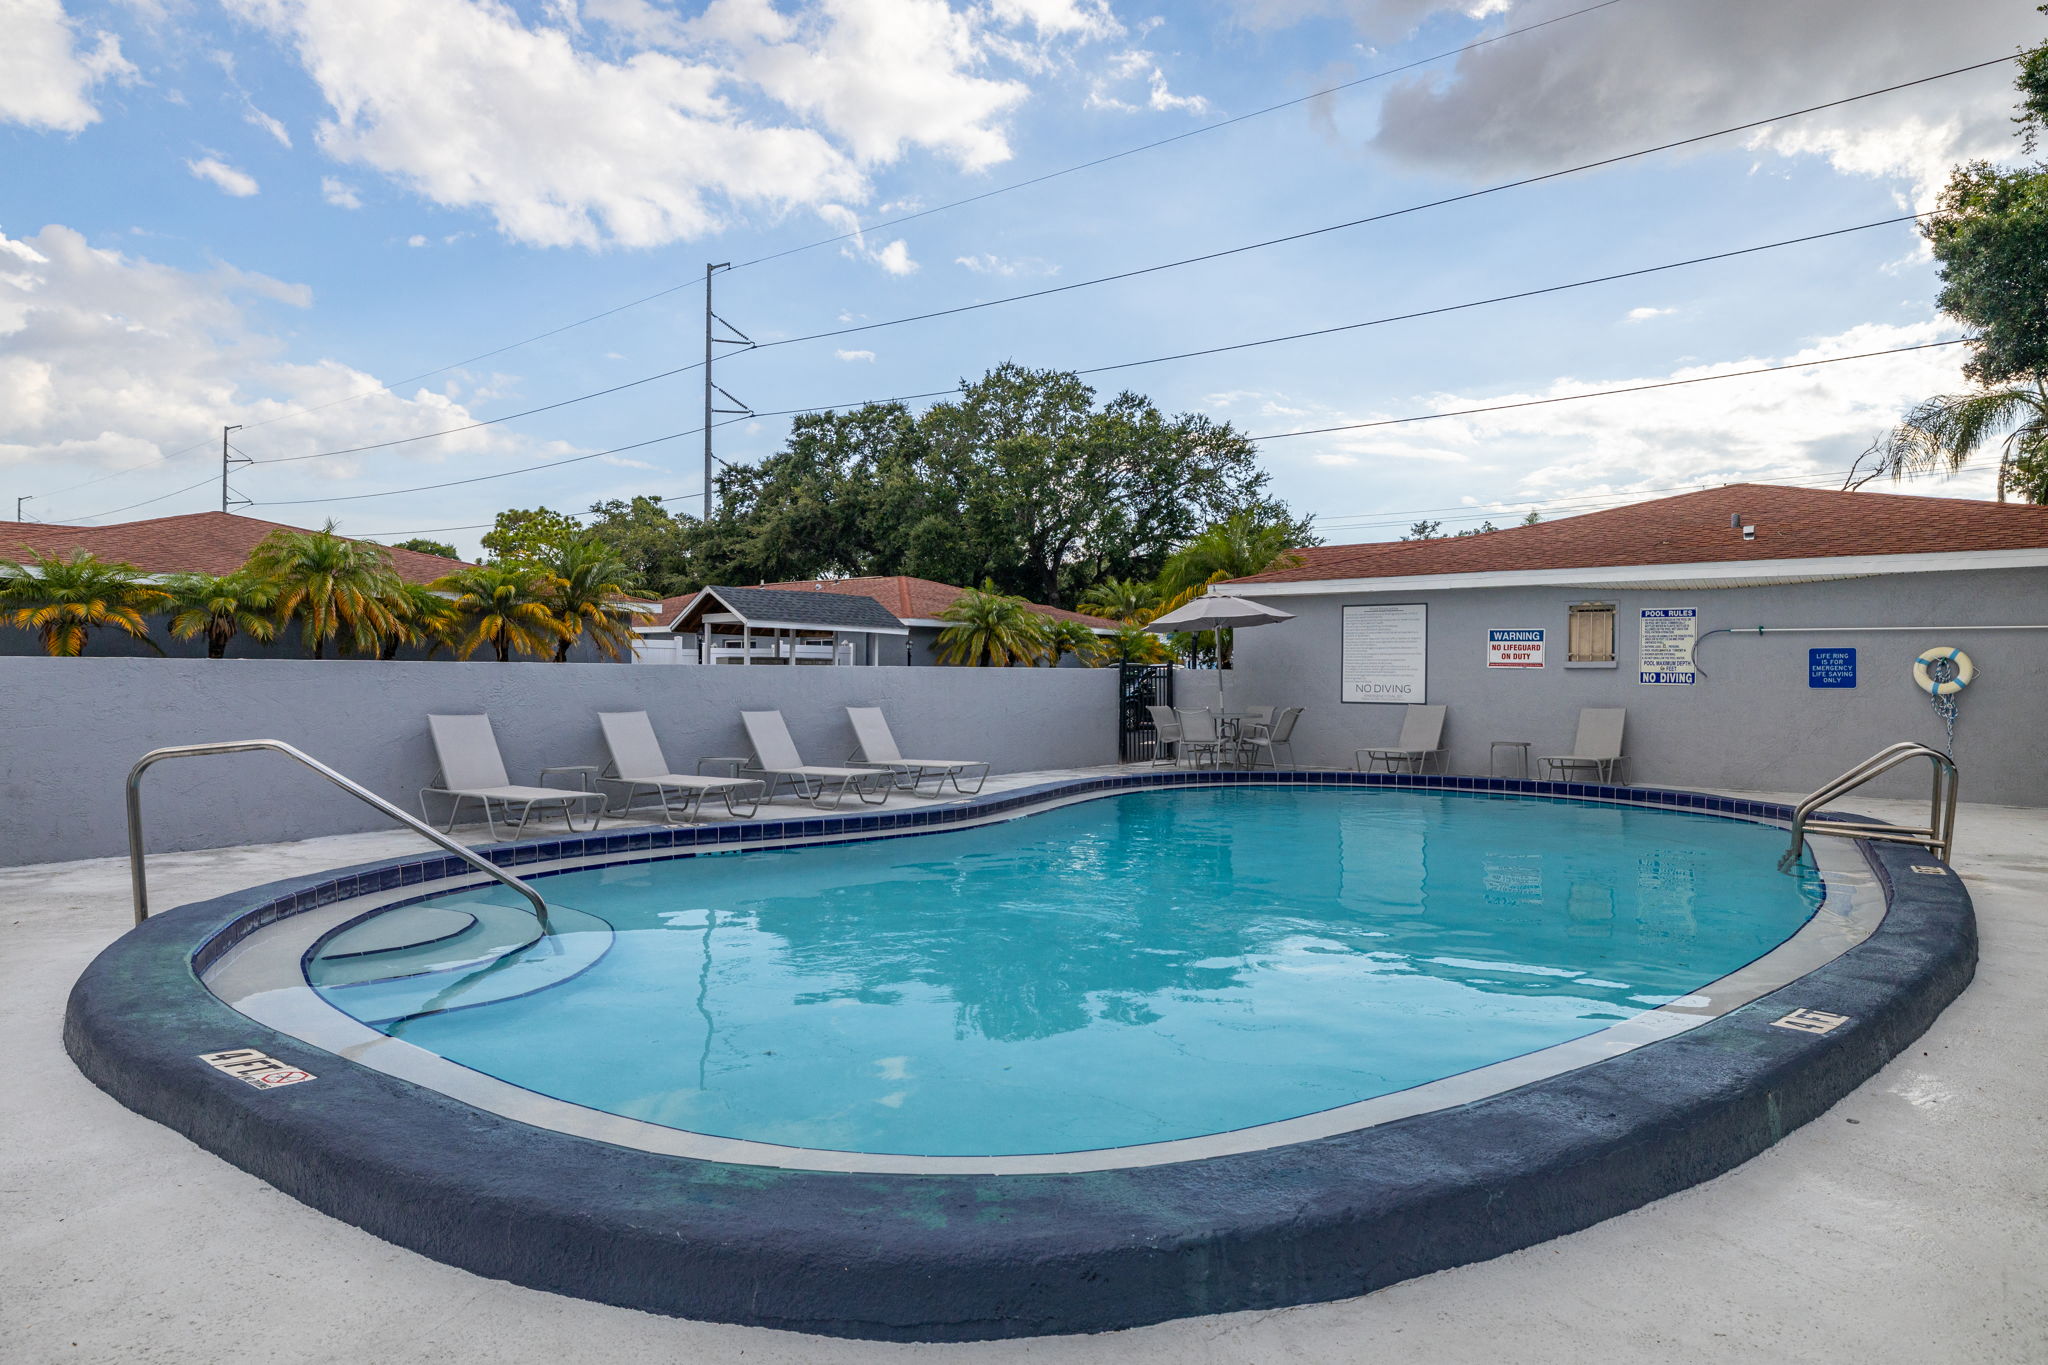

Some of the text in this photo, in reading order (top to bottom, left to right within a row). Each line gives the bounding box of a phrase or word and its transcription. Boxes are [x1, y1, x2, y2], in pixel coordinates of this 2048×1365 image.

[1493, 631, 1540, 641] WARNING
[1642, 672, 1693, 683] NO DIVING
[1355, 684, 1412, 694] NO DIVING
[210, 1052, 254, 1062] 4
